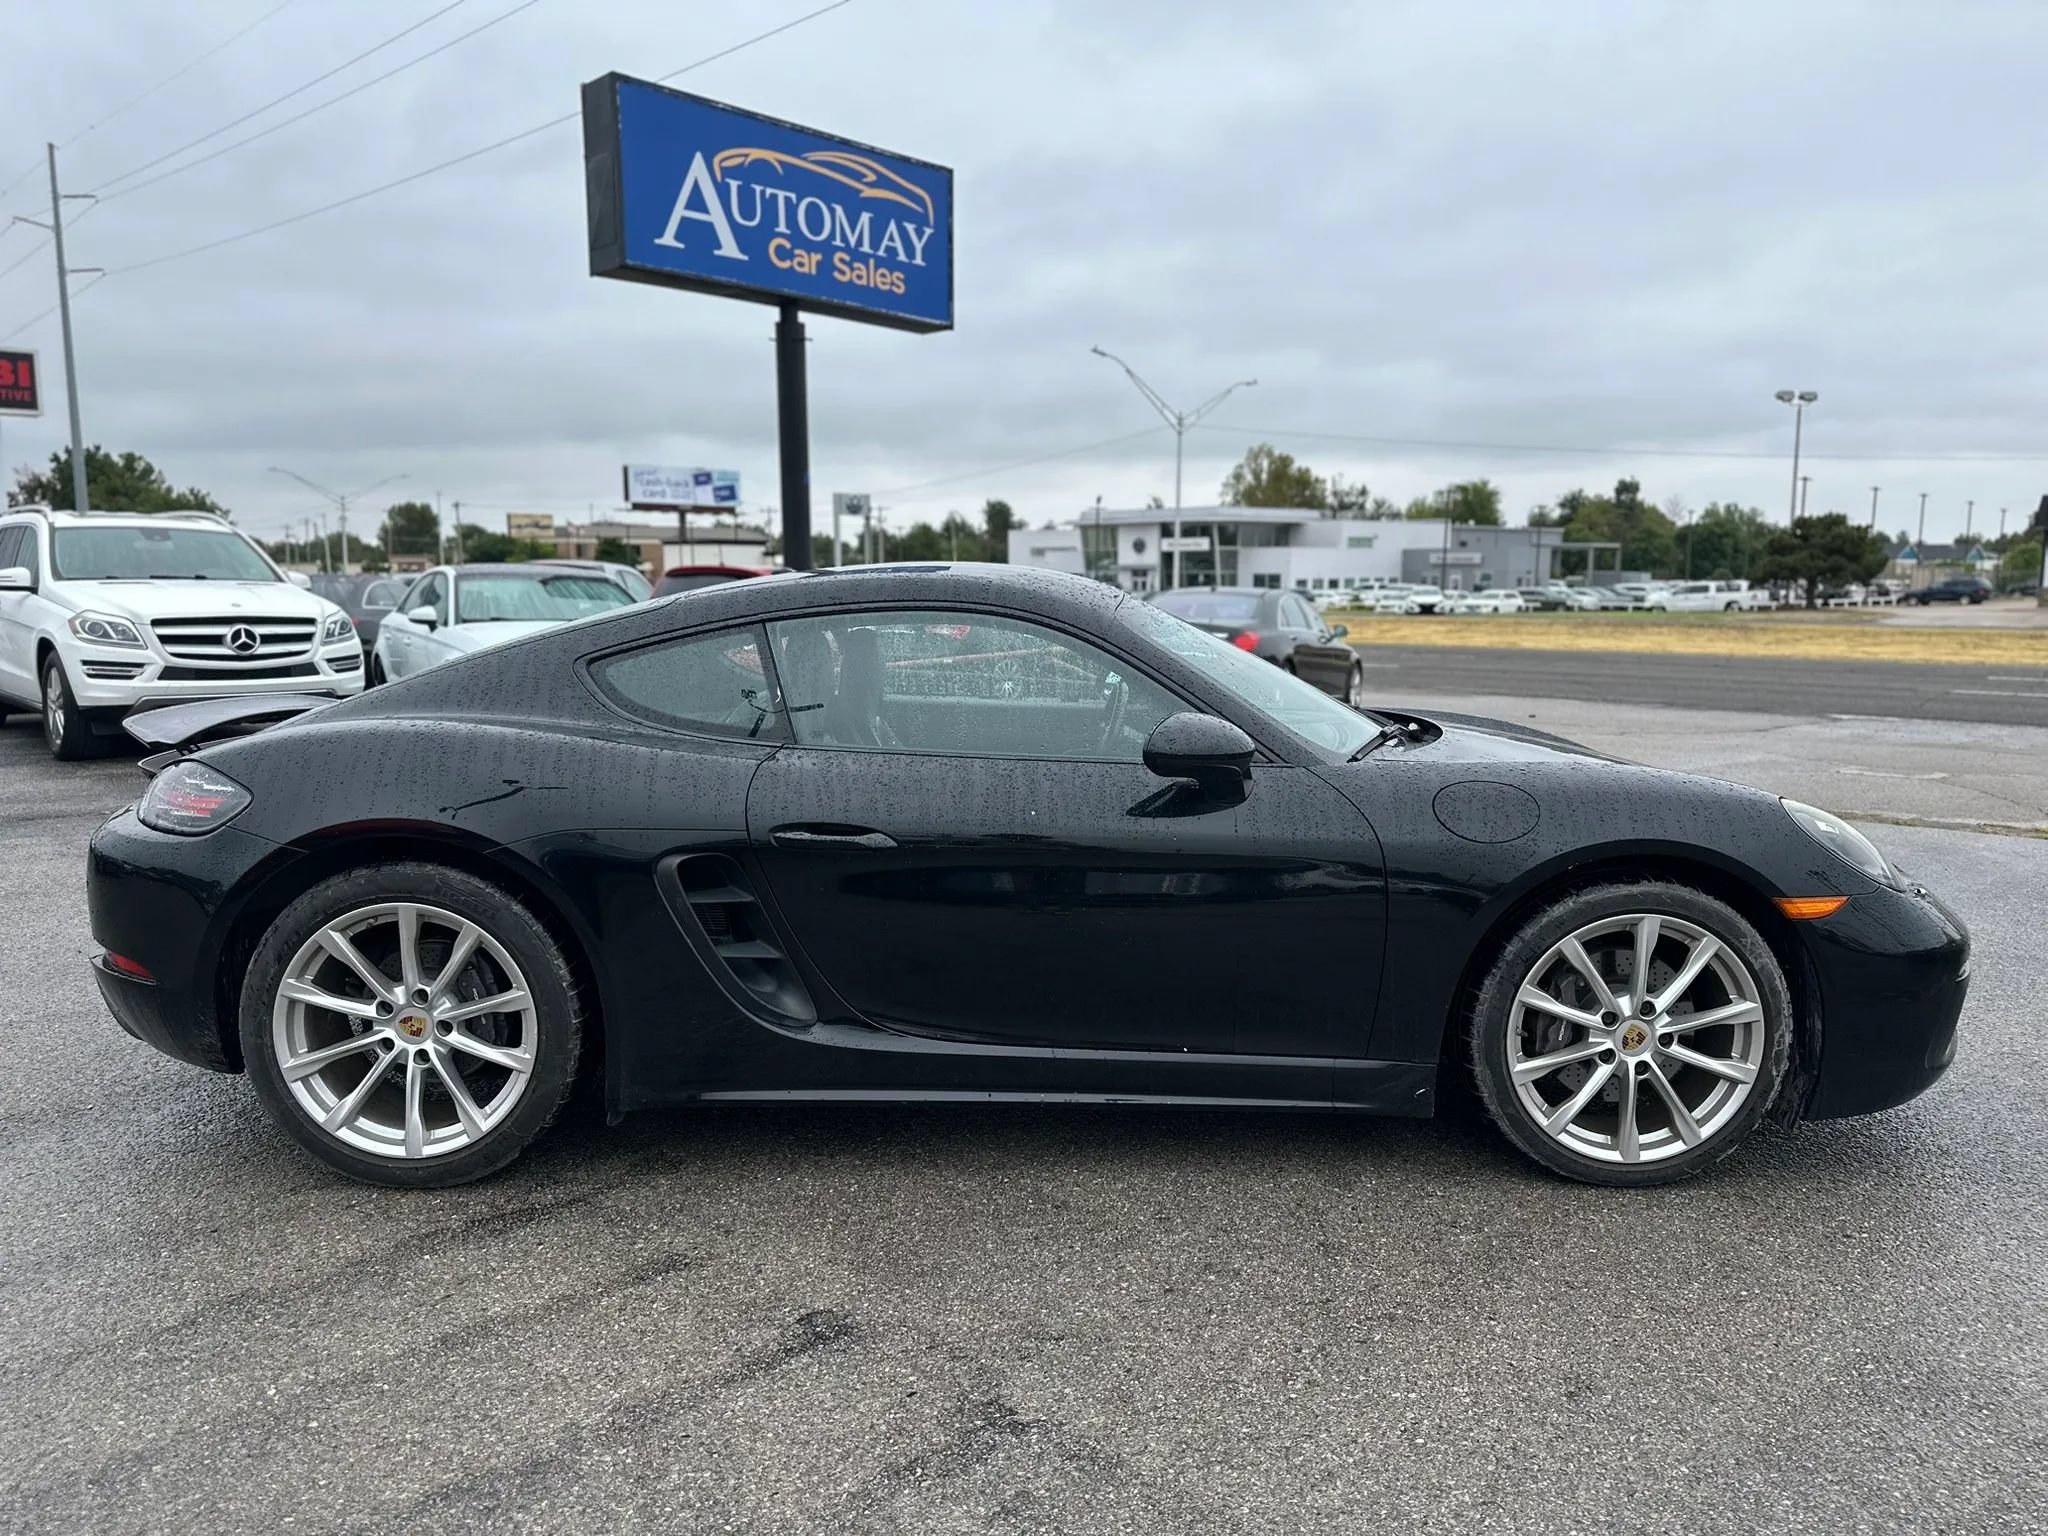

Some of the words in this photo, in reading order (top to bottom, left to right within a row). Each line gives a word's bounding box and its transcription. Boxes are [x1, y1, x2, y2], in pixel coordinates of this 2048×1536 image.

[654, 151, 935, 267] AUTOMAY
[768, 237, 823, 276] Car
[832, 252, 906, 294] Sales
